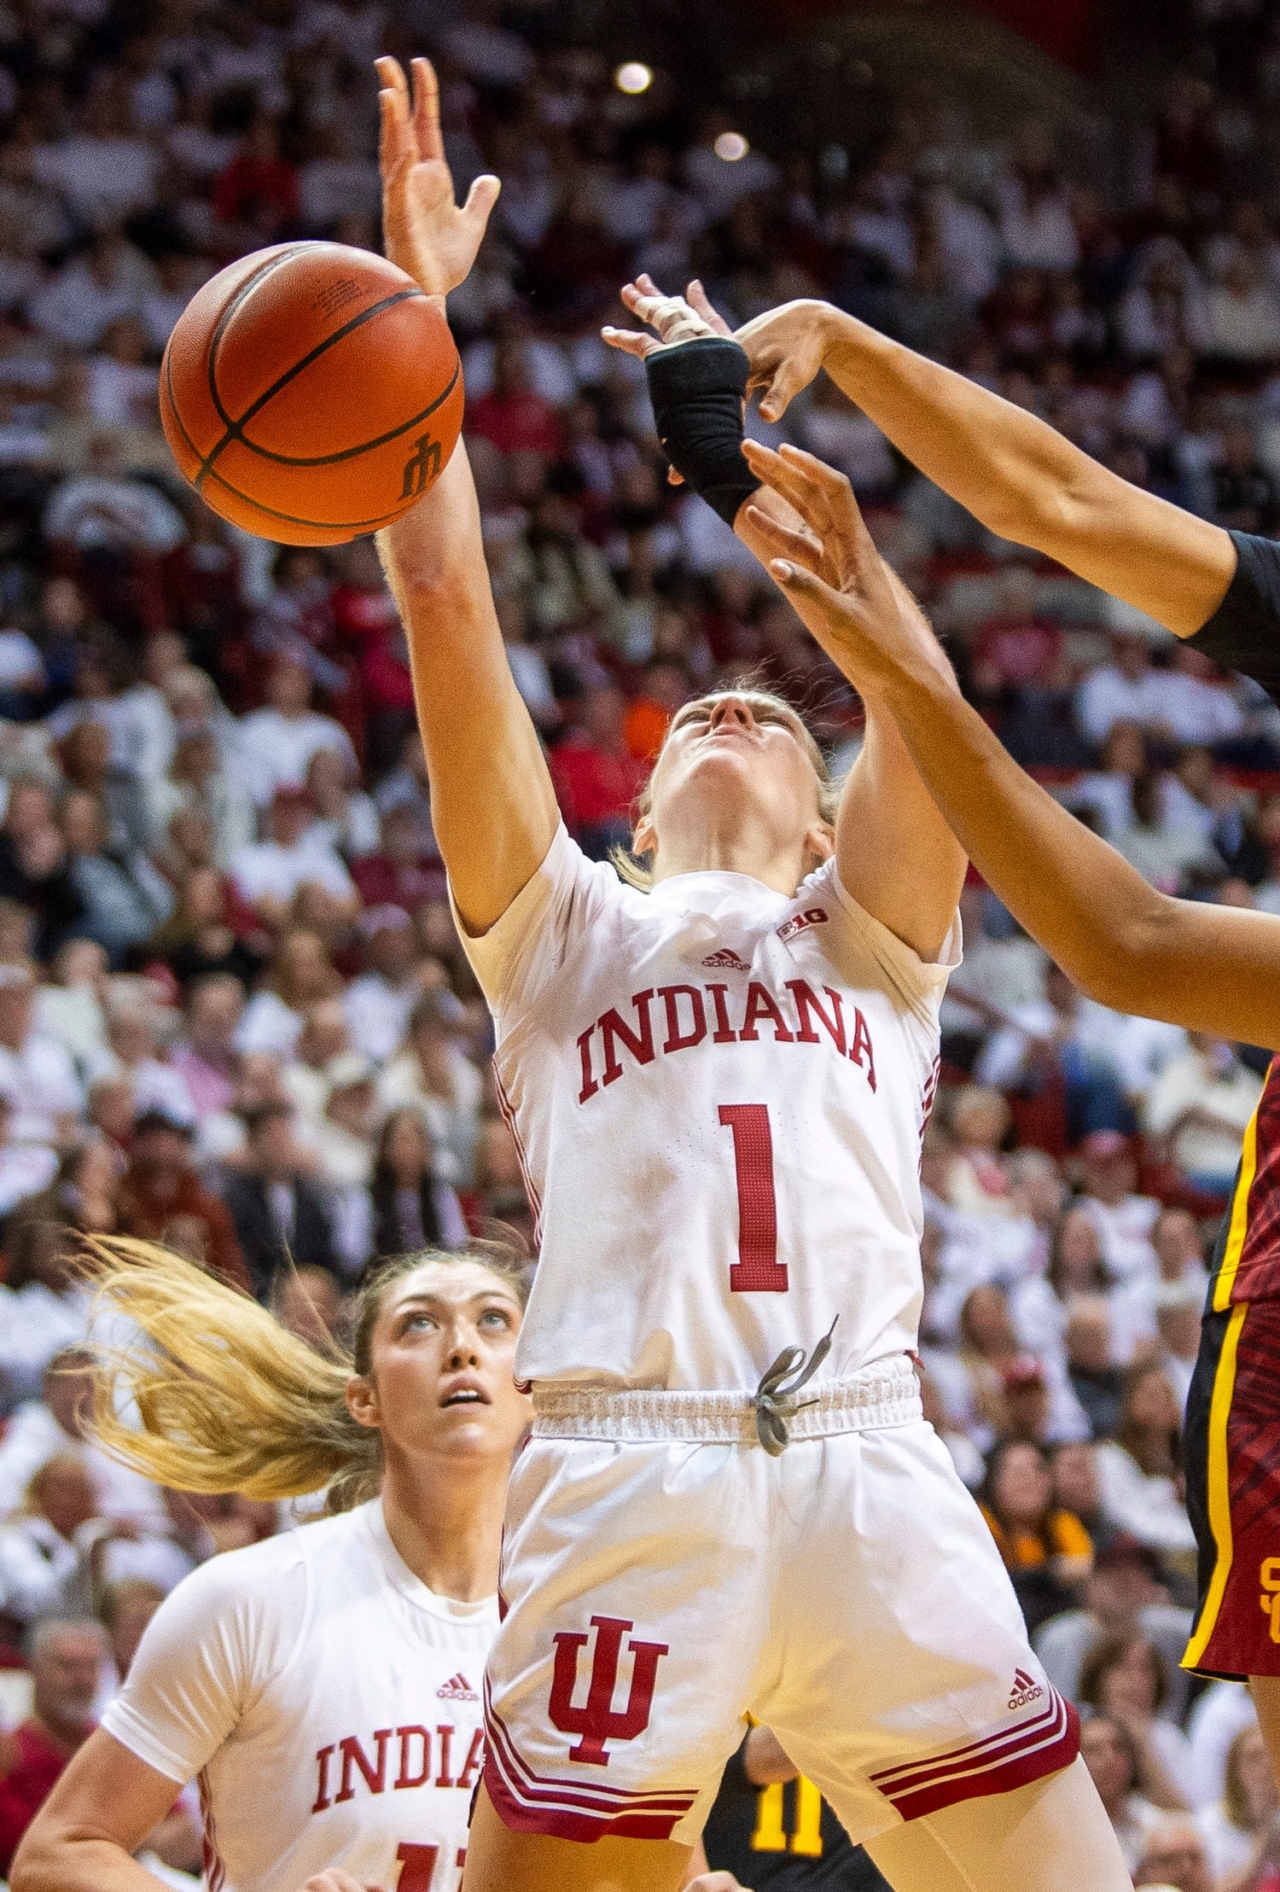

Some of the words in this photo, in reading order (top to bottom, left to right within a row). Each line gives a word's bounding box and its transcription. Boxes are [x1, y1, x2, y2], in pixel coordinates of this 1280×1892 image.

[701, 957, 752, 972] adidas
[576, 978, 878, 1105] INDIANA
[717, 1104, 789, 1292] 1
[436, 1689, 480, 1701] adidas
[548, 1614, 670, 1767] IU
[1008, 1685, 1044, 1710] adidas
[751, 1774, 823, 1858] 11
